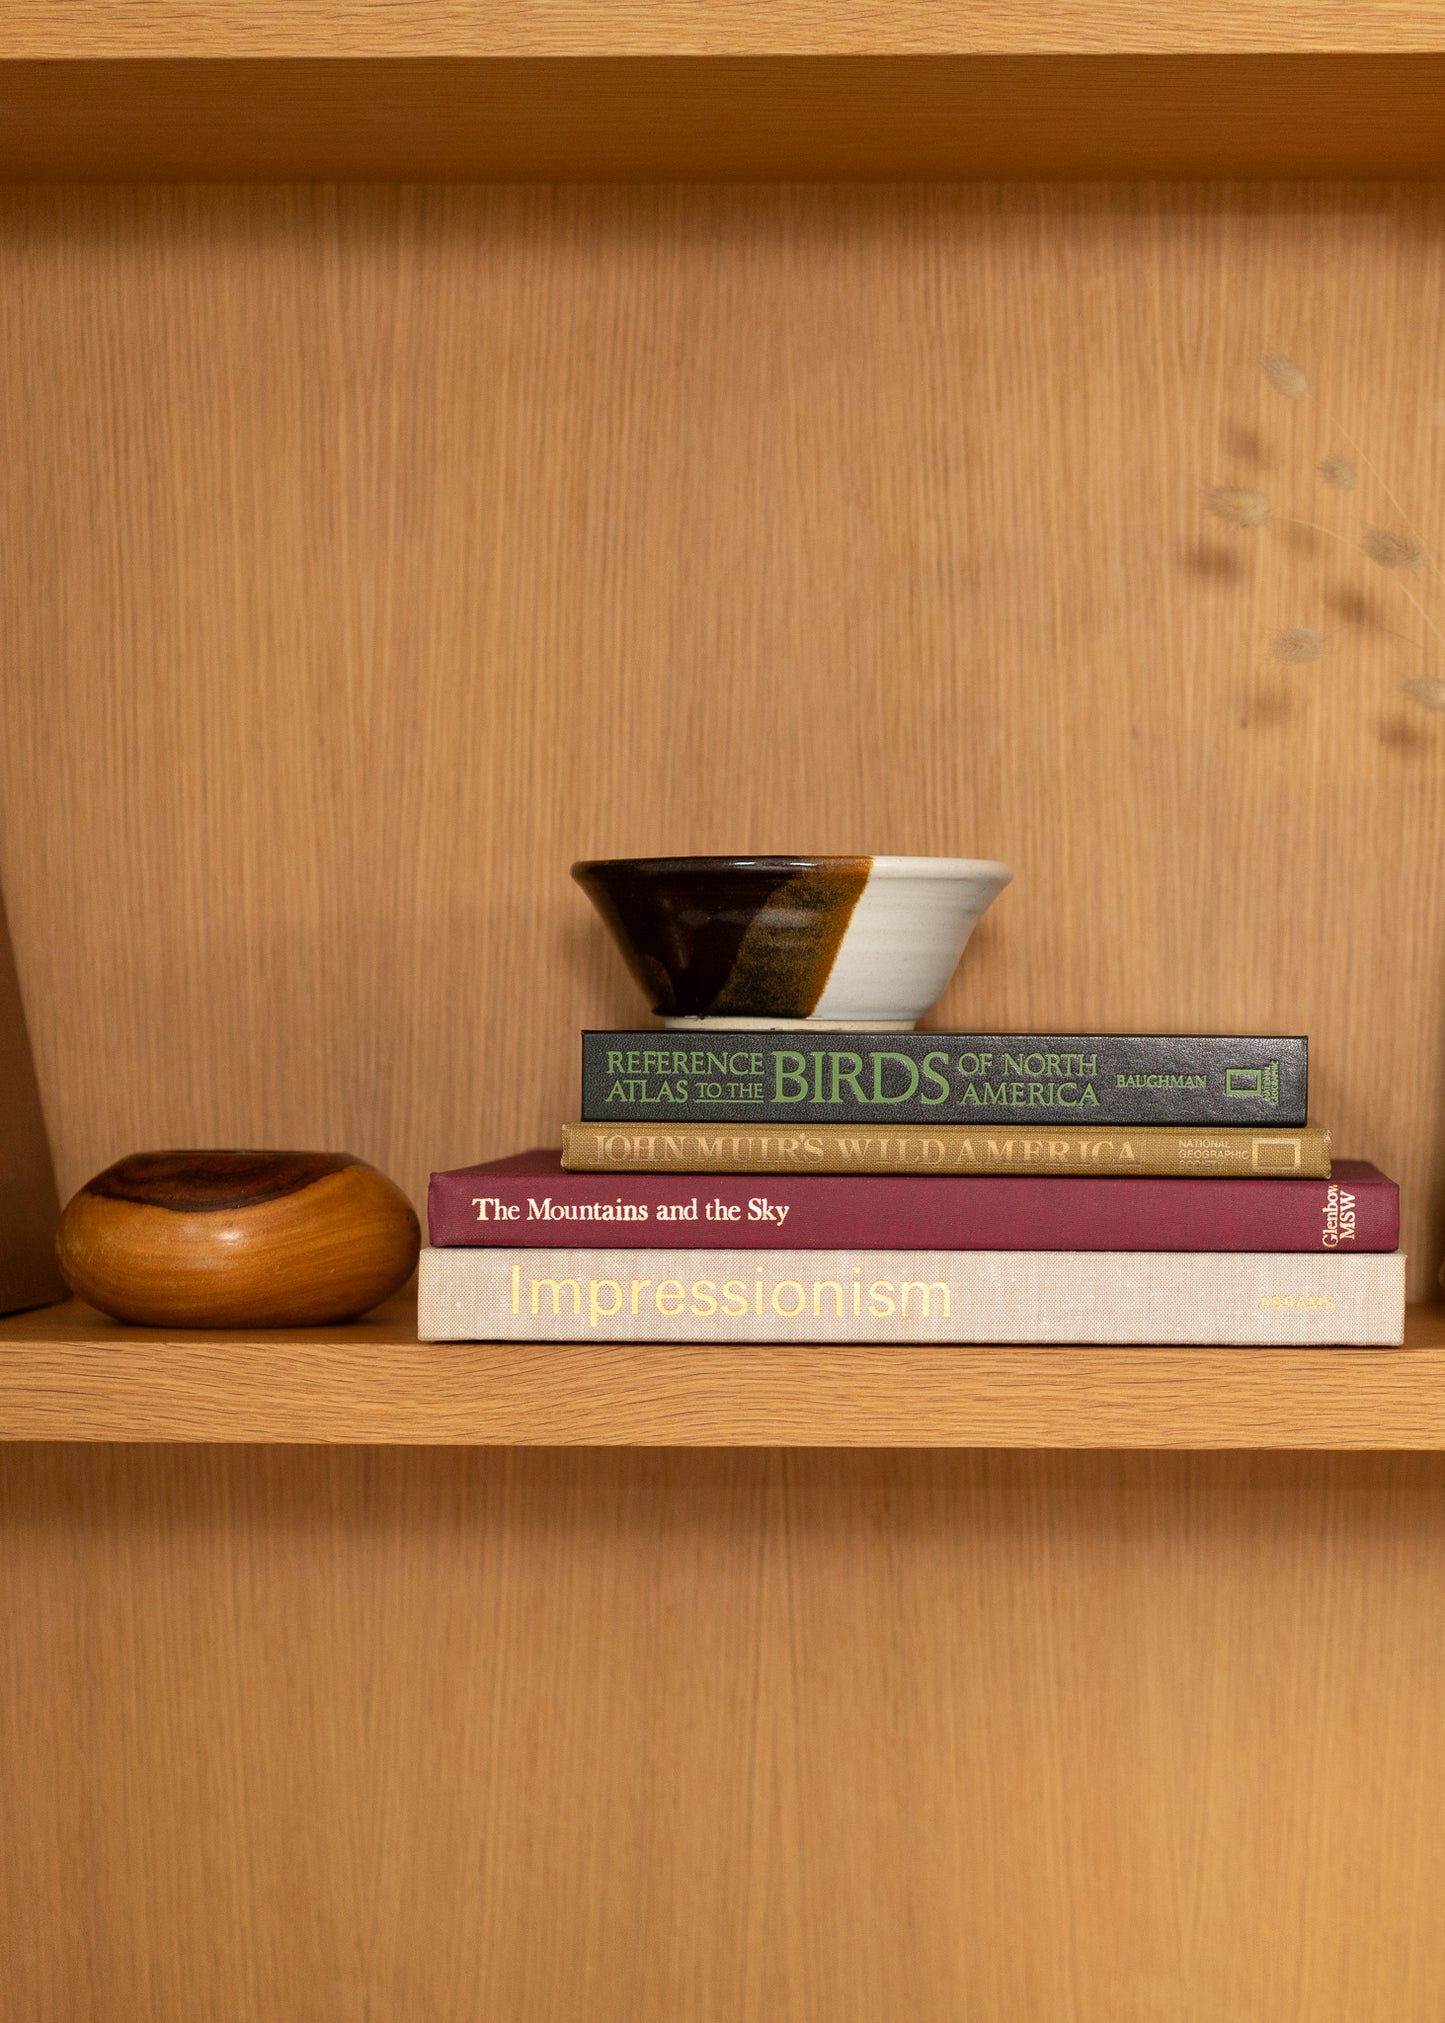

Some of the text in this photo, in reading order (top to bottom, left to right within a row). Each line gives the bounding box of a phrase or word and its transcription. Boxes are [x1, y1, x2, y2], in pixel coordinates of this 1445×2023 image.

[606, 1051, 765, 1076] REFERENCE
[958, 1052, 1098, 1077] OF NORTH
[770, 1051, 950, 1105] BIRDS
[1116, 1074, 1207, 1089] BAUGHMAN
[1271, 1060, 1279, 1104] GEOGRAPHIC
[605, 1079, 764, 1103] ATLAS TO THE
[960, 1082, 1100, 1107] AMERICA
[589, 1133, 1140, 1167] JOHN MUIR'S WILD AMERICA
[1178, 1139, 1231, 1149] NATIONAL
[1178, 1149, 1250, 1160] GEOGRAPHIC
[1178, 1159, 1225, 1169] SOCIETY
[472, 1197, 789, 1227] The Mountains and the Sky
[1340, 1191, 1356, 1240] MSW
[510, 1264, 952, 1328] Impressionism
[1257, 1295, 1335, 1311] ABRAMS
